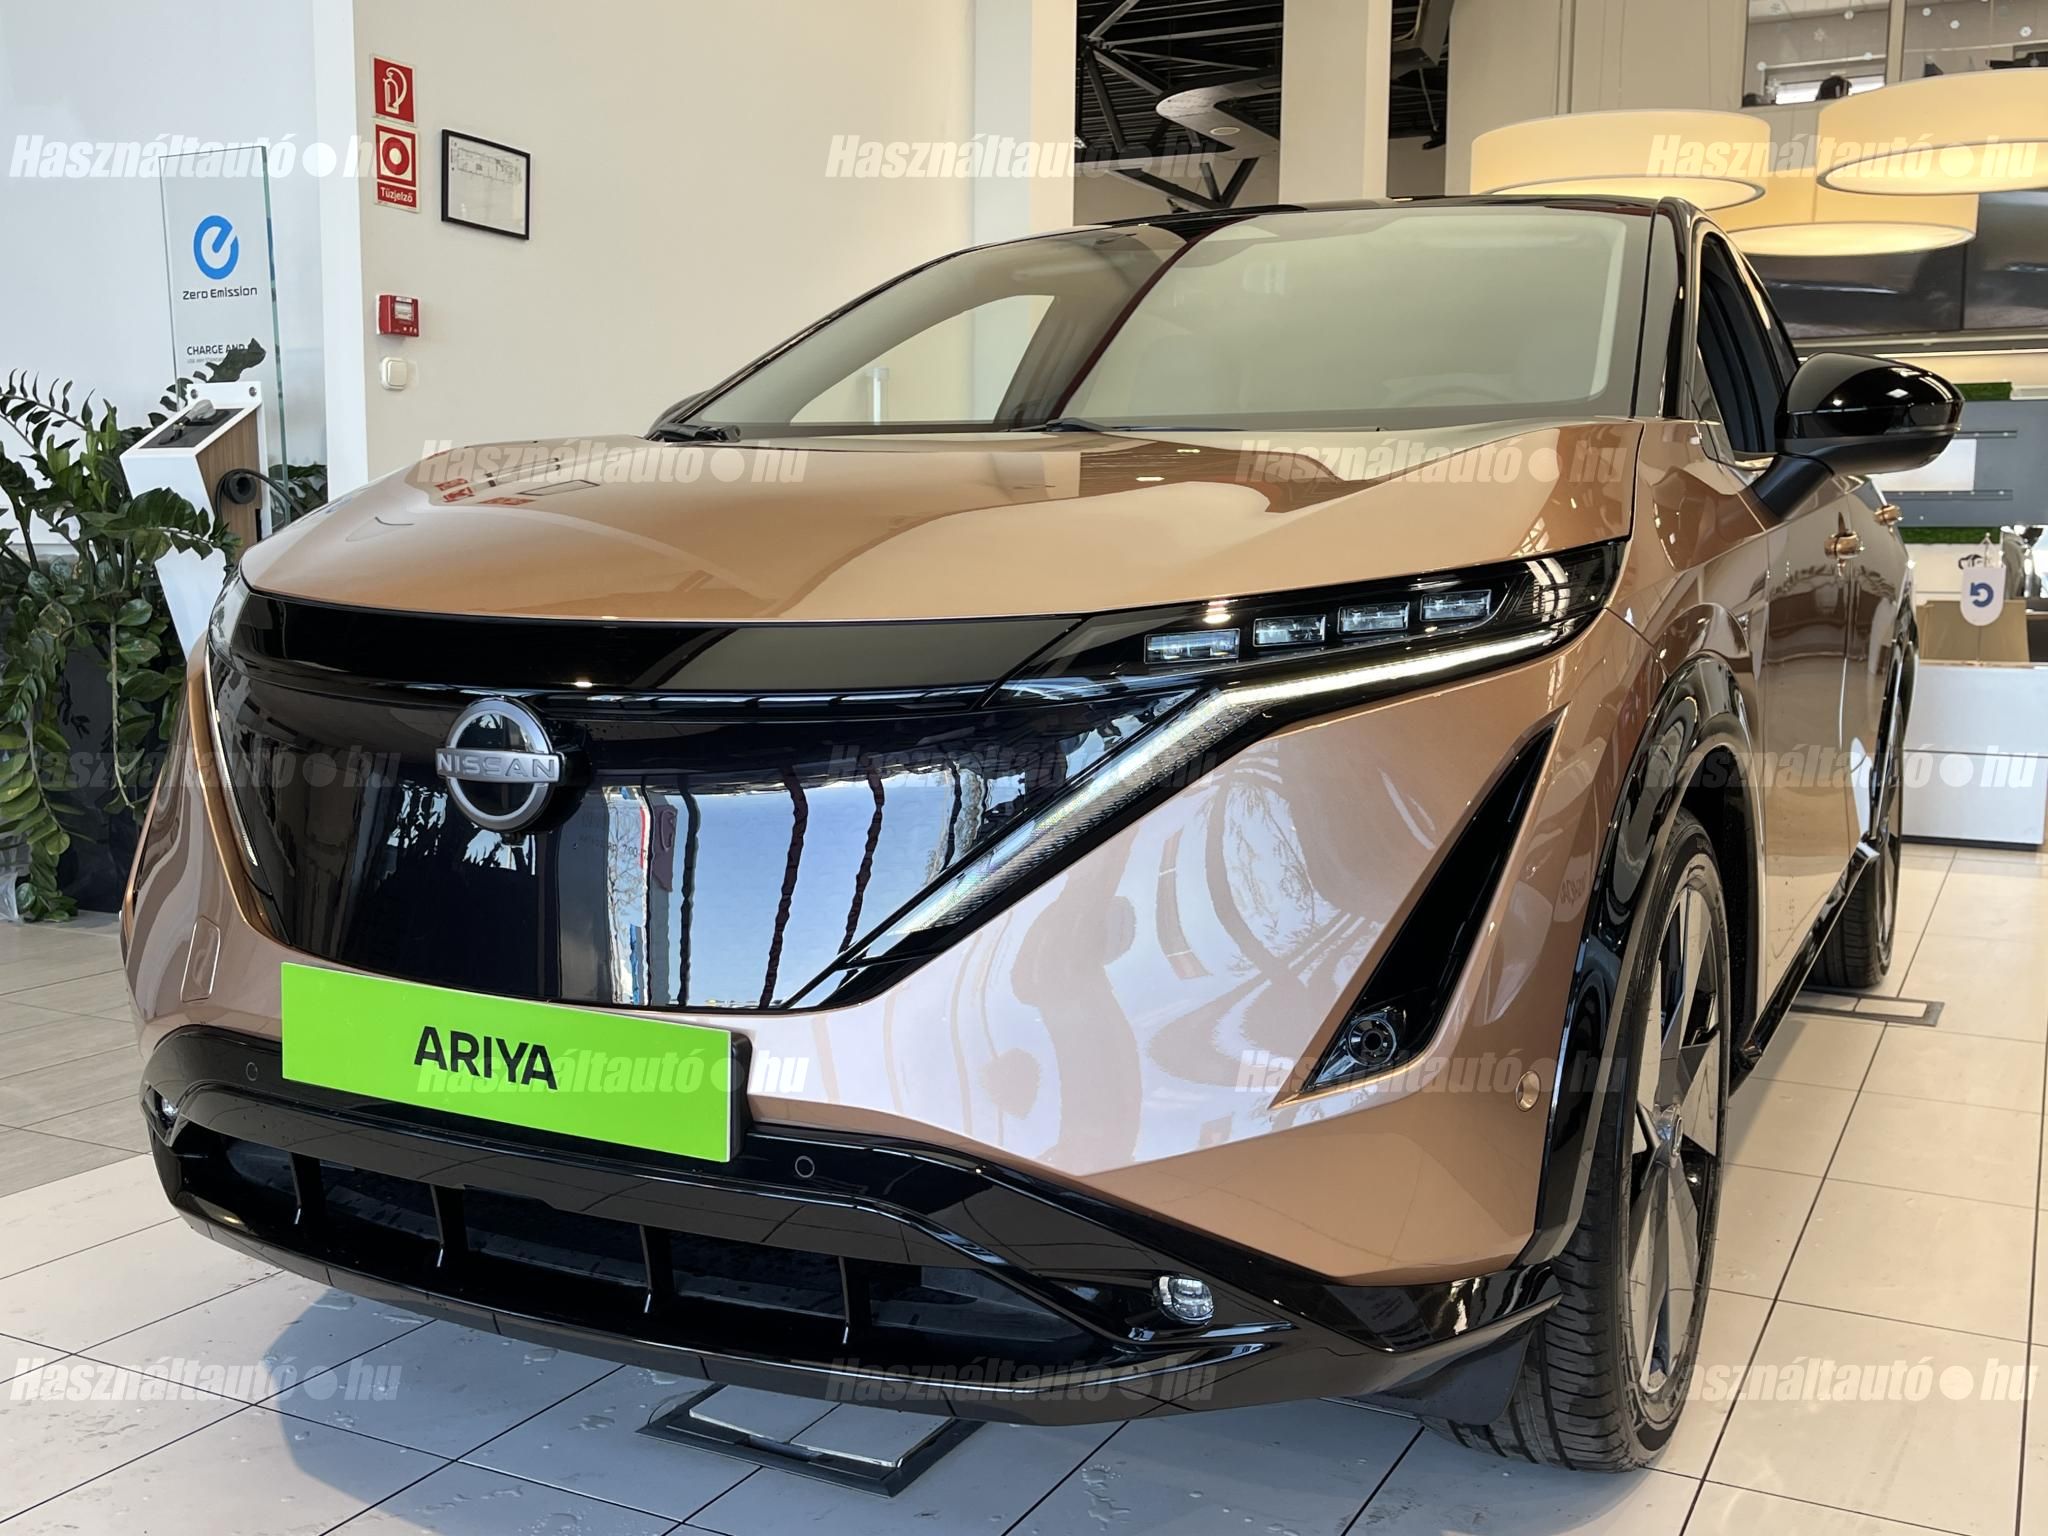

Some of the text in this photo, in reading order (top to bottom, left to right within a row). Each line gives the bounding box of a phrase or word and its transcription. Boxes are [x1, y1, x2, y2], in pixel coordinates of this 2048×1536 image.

[182, 285, 257, 300] Zero Emission
[187, 345, 223, 355] CHARGE
[437, 752, 555, 778] NISSAN
[414, 1025, 558, 1091] ARIYA
